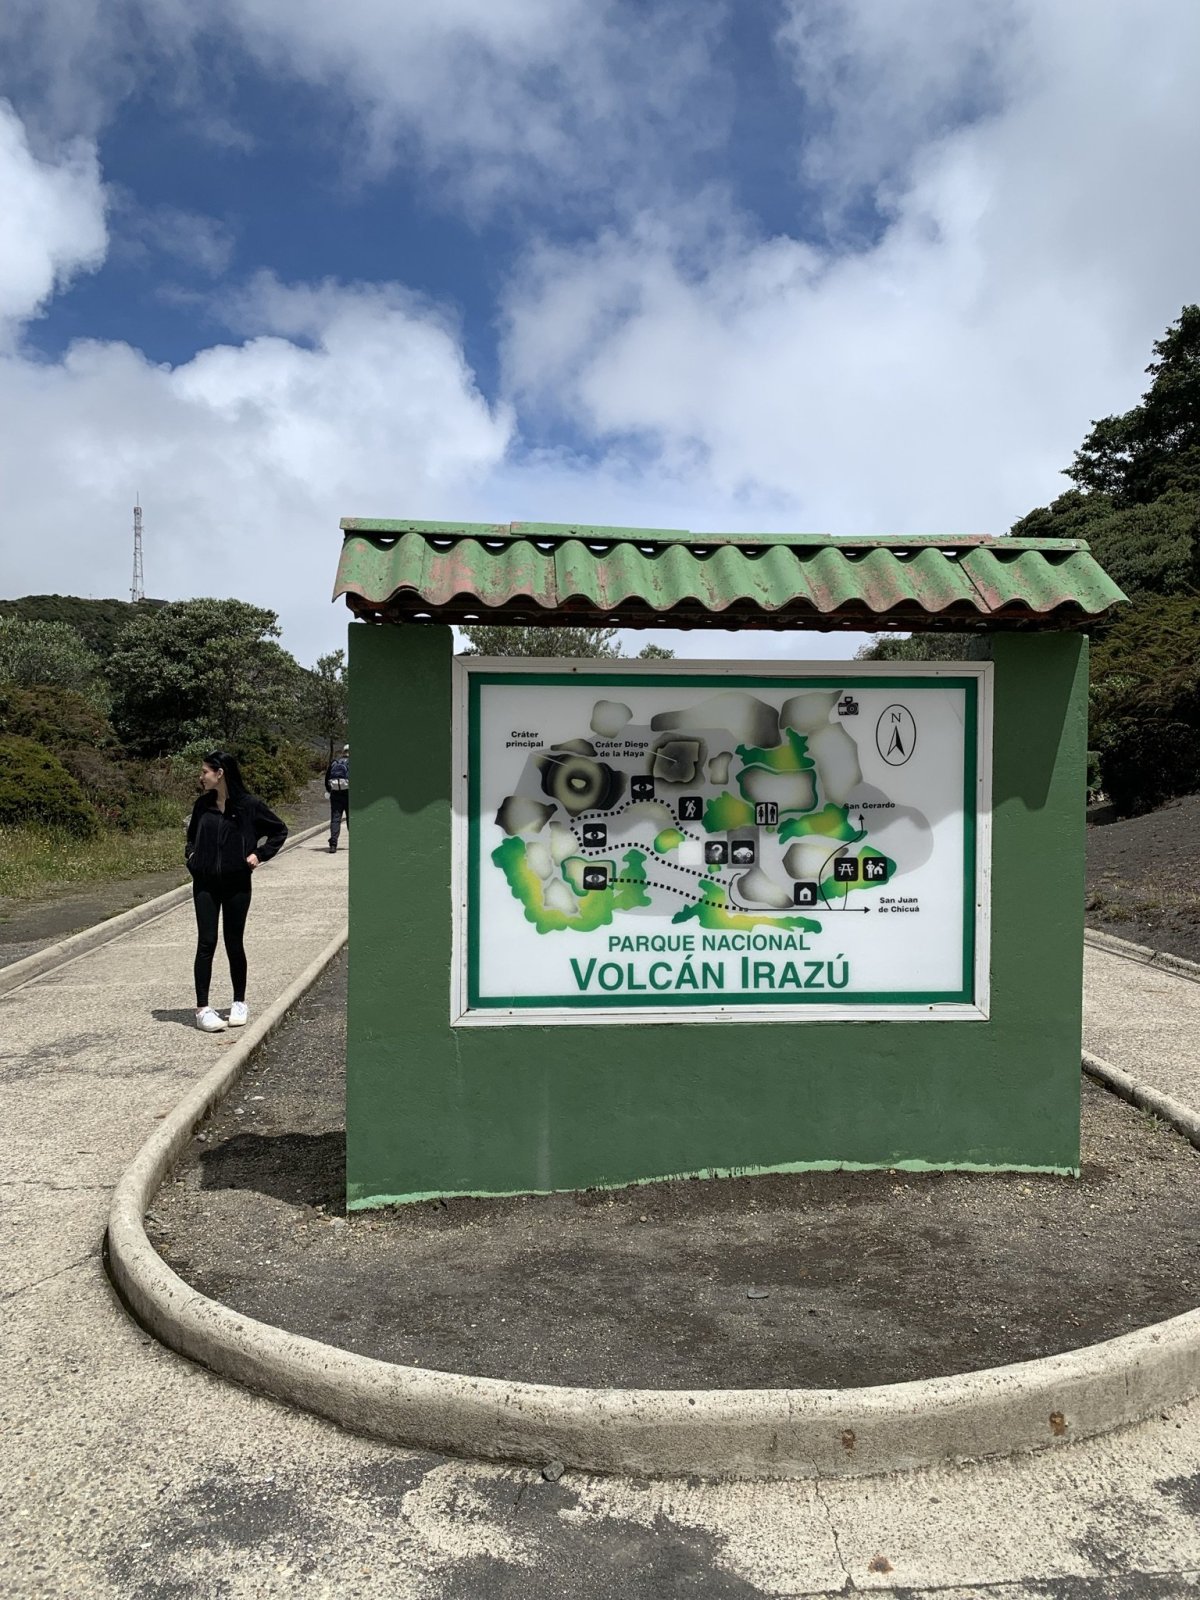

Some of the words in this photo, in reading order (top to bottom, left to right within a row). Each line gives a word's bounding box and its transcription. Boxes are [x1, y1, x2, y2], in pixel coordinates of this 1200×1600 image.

[891, 713, 902, 723] N
[506, 740, 544, 748] principal
[625, 741, 649, 749] Diego
[623, 750, 645, 758] Haya
[897, 896, 919, 904] Juan
[891, 905, 920, 913] Chicuá
[609, 935, 695, 952] PARQUE
[702, 934, 811, 951] NACIONAL
[569, 954, 724, 991] VOLCÁN
[741, 953, 850, 989] IRAZÚ
